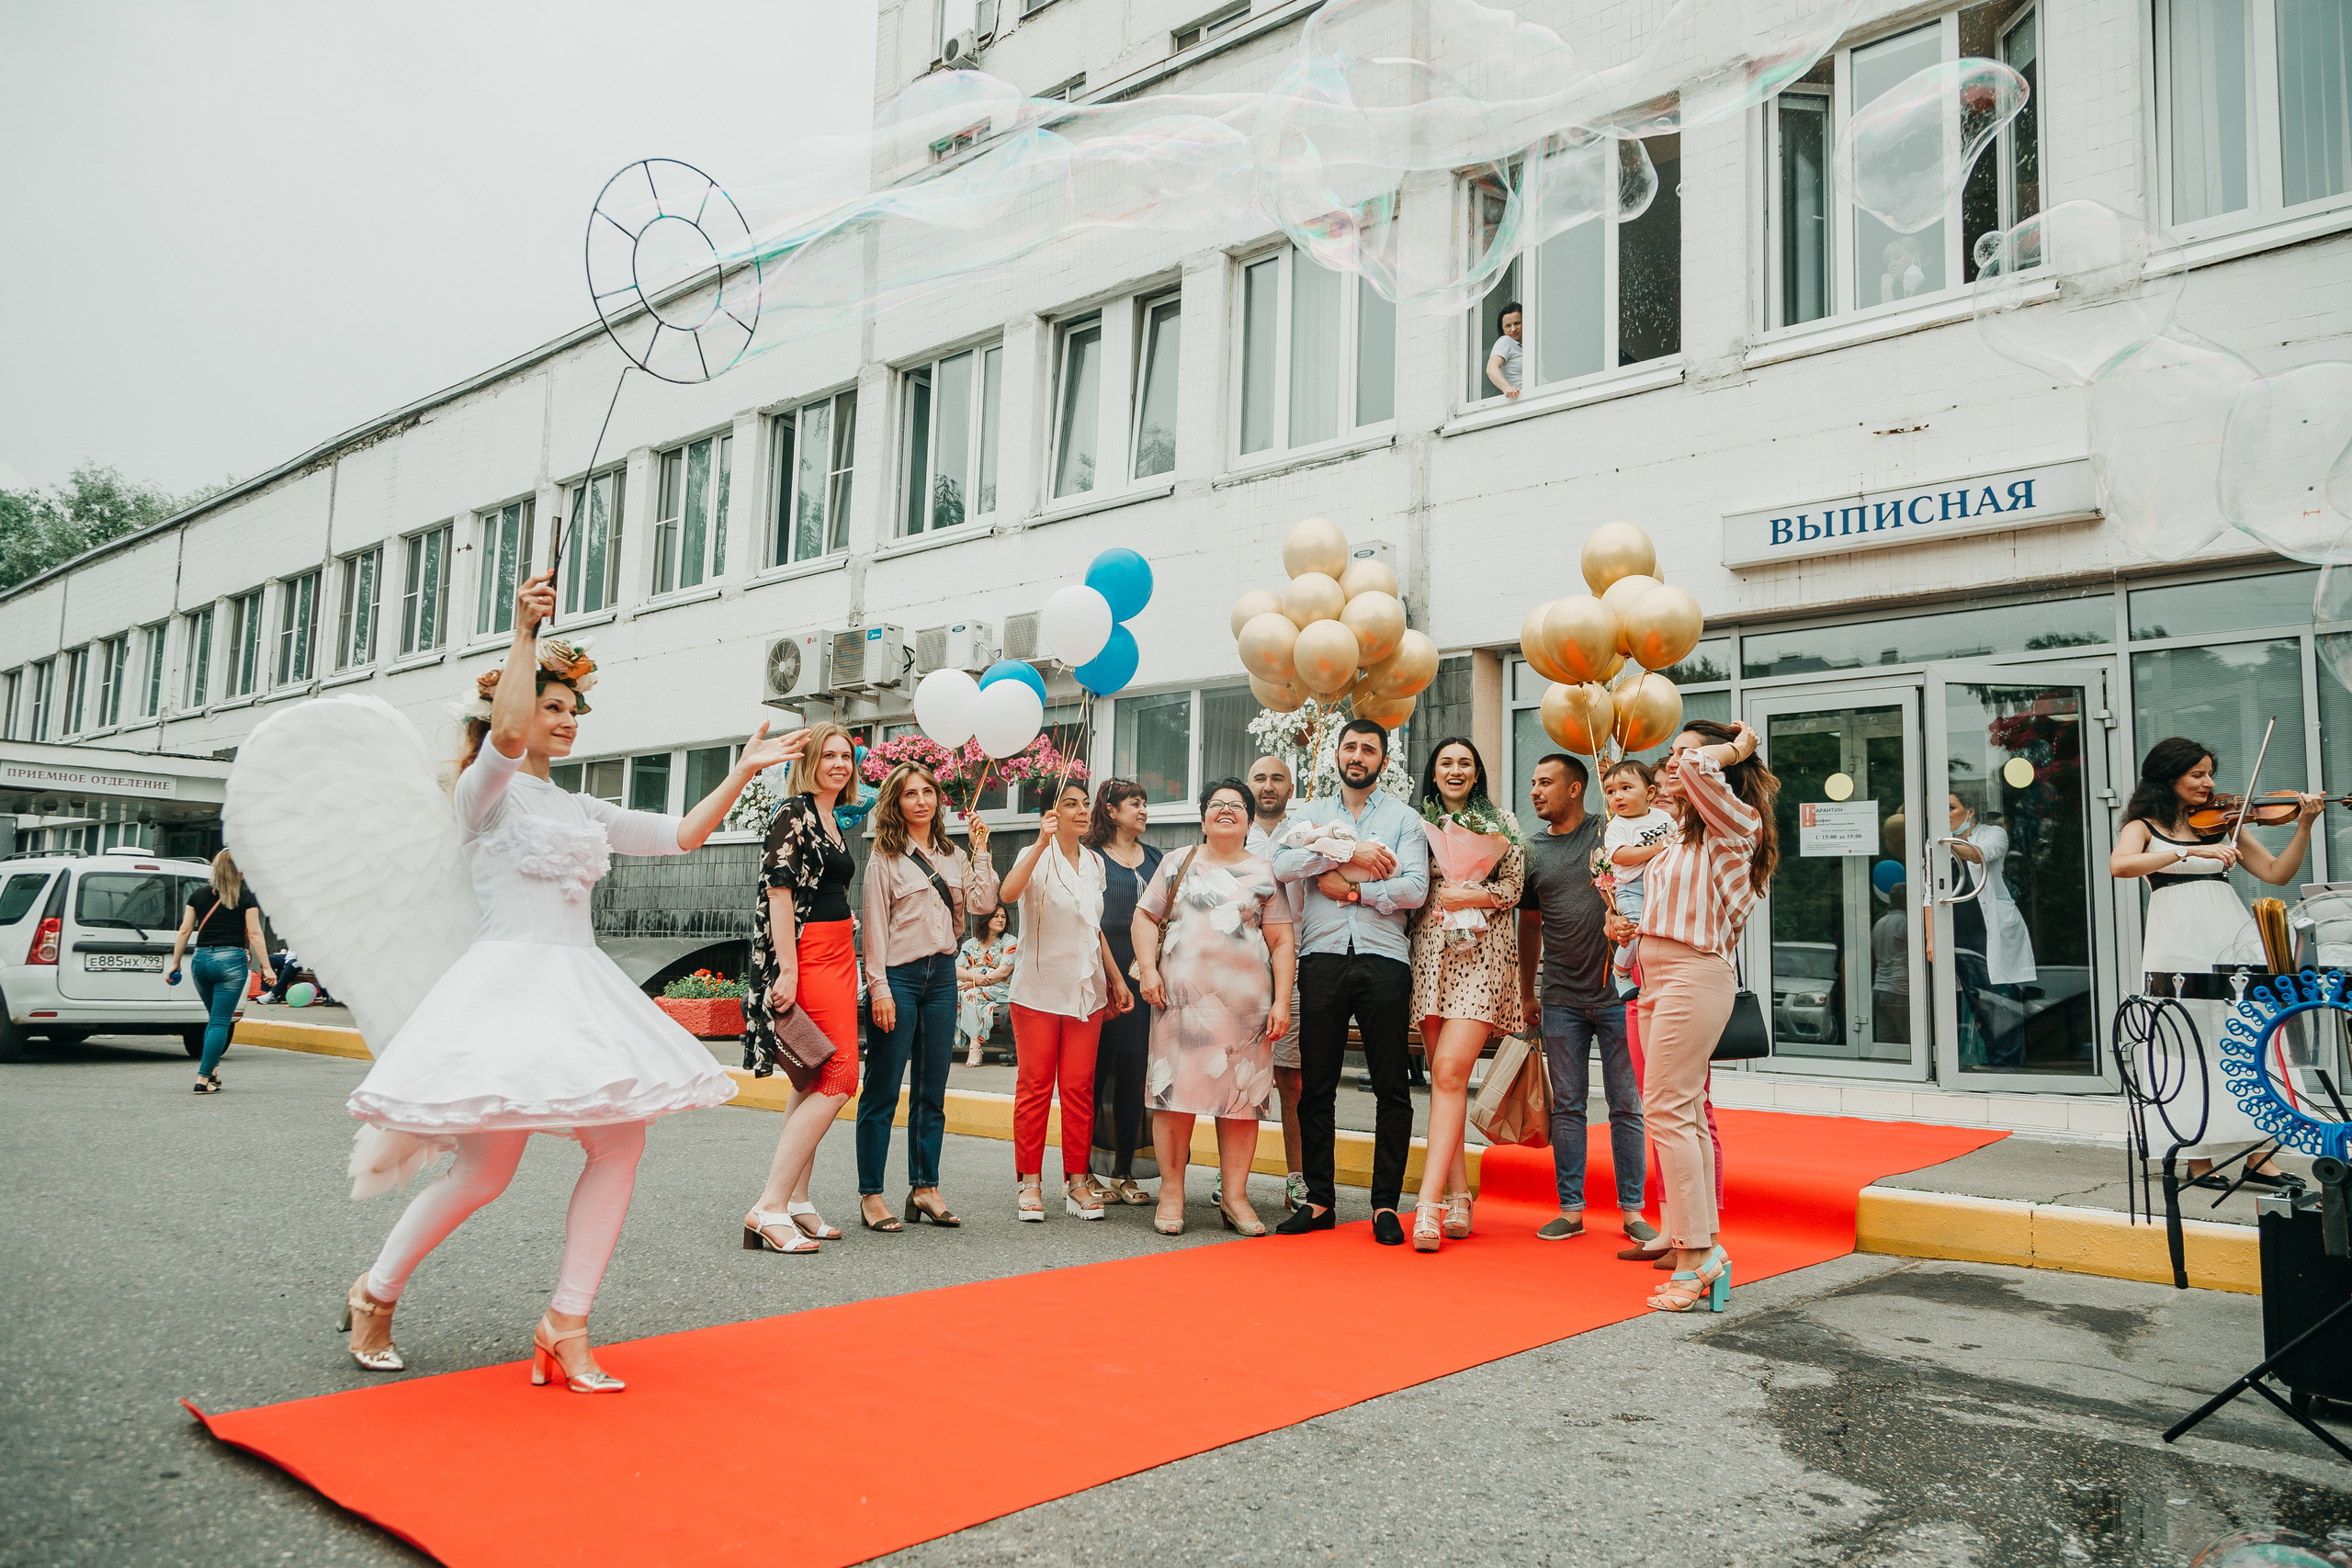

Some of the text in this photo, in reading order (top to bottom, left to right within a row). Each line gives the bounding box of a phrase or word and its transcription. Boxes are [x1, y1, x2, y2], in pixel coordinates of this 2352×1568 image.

[1770, 479, 2037, 546] ВЫПИСНАЯ
[6, 768, 171, 790] ПРИЕМНОЕ ОТДЕЛЕНИЕ
[141, 956, 160, 965] 799
